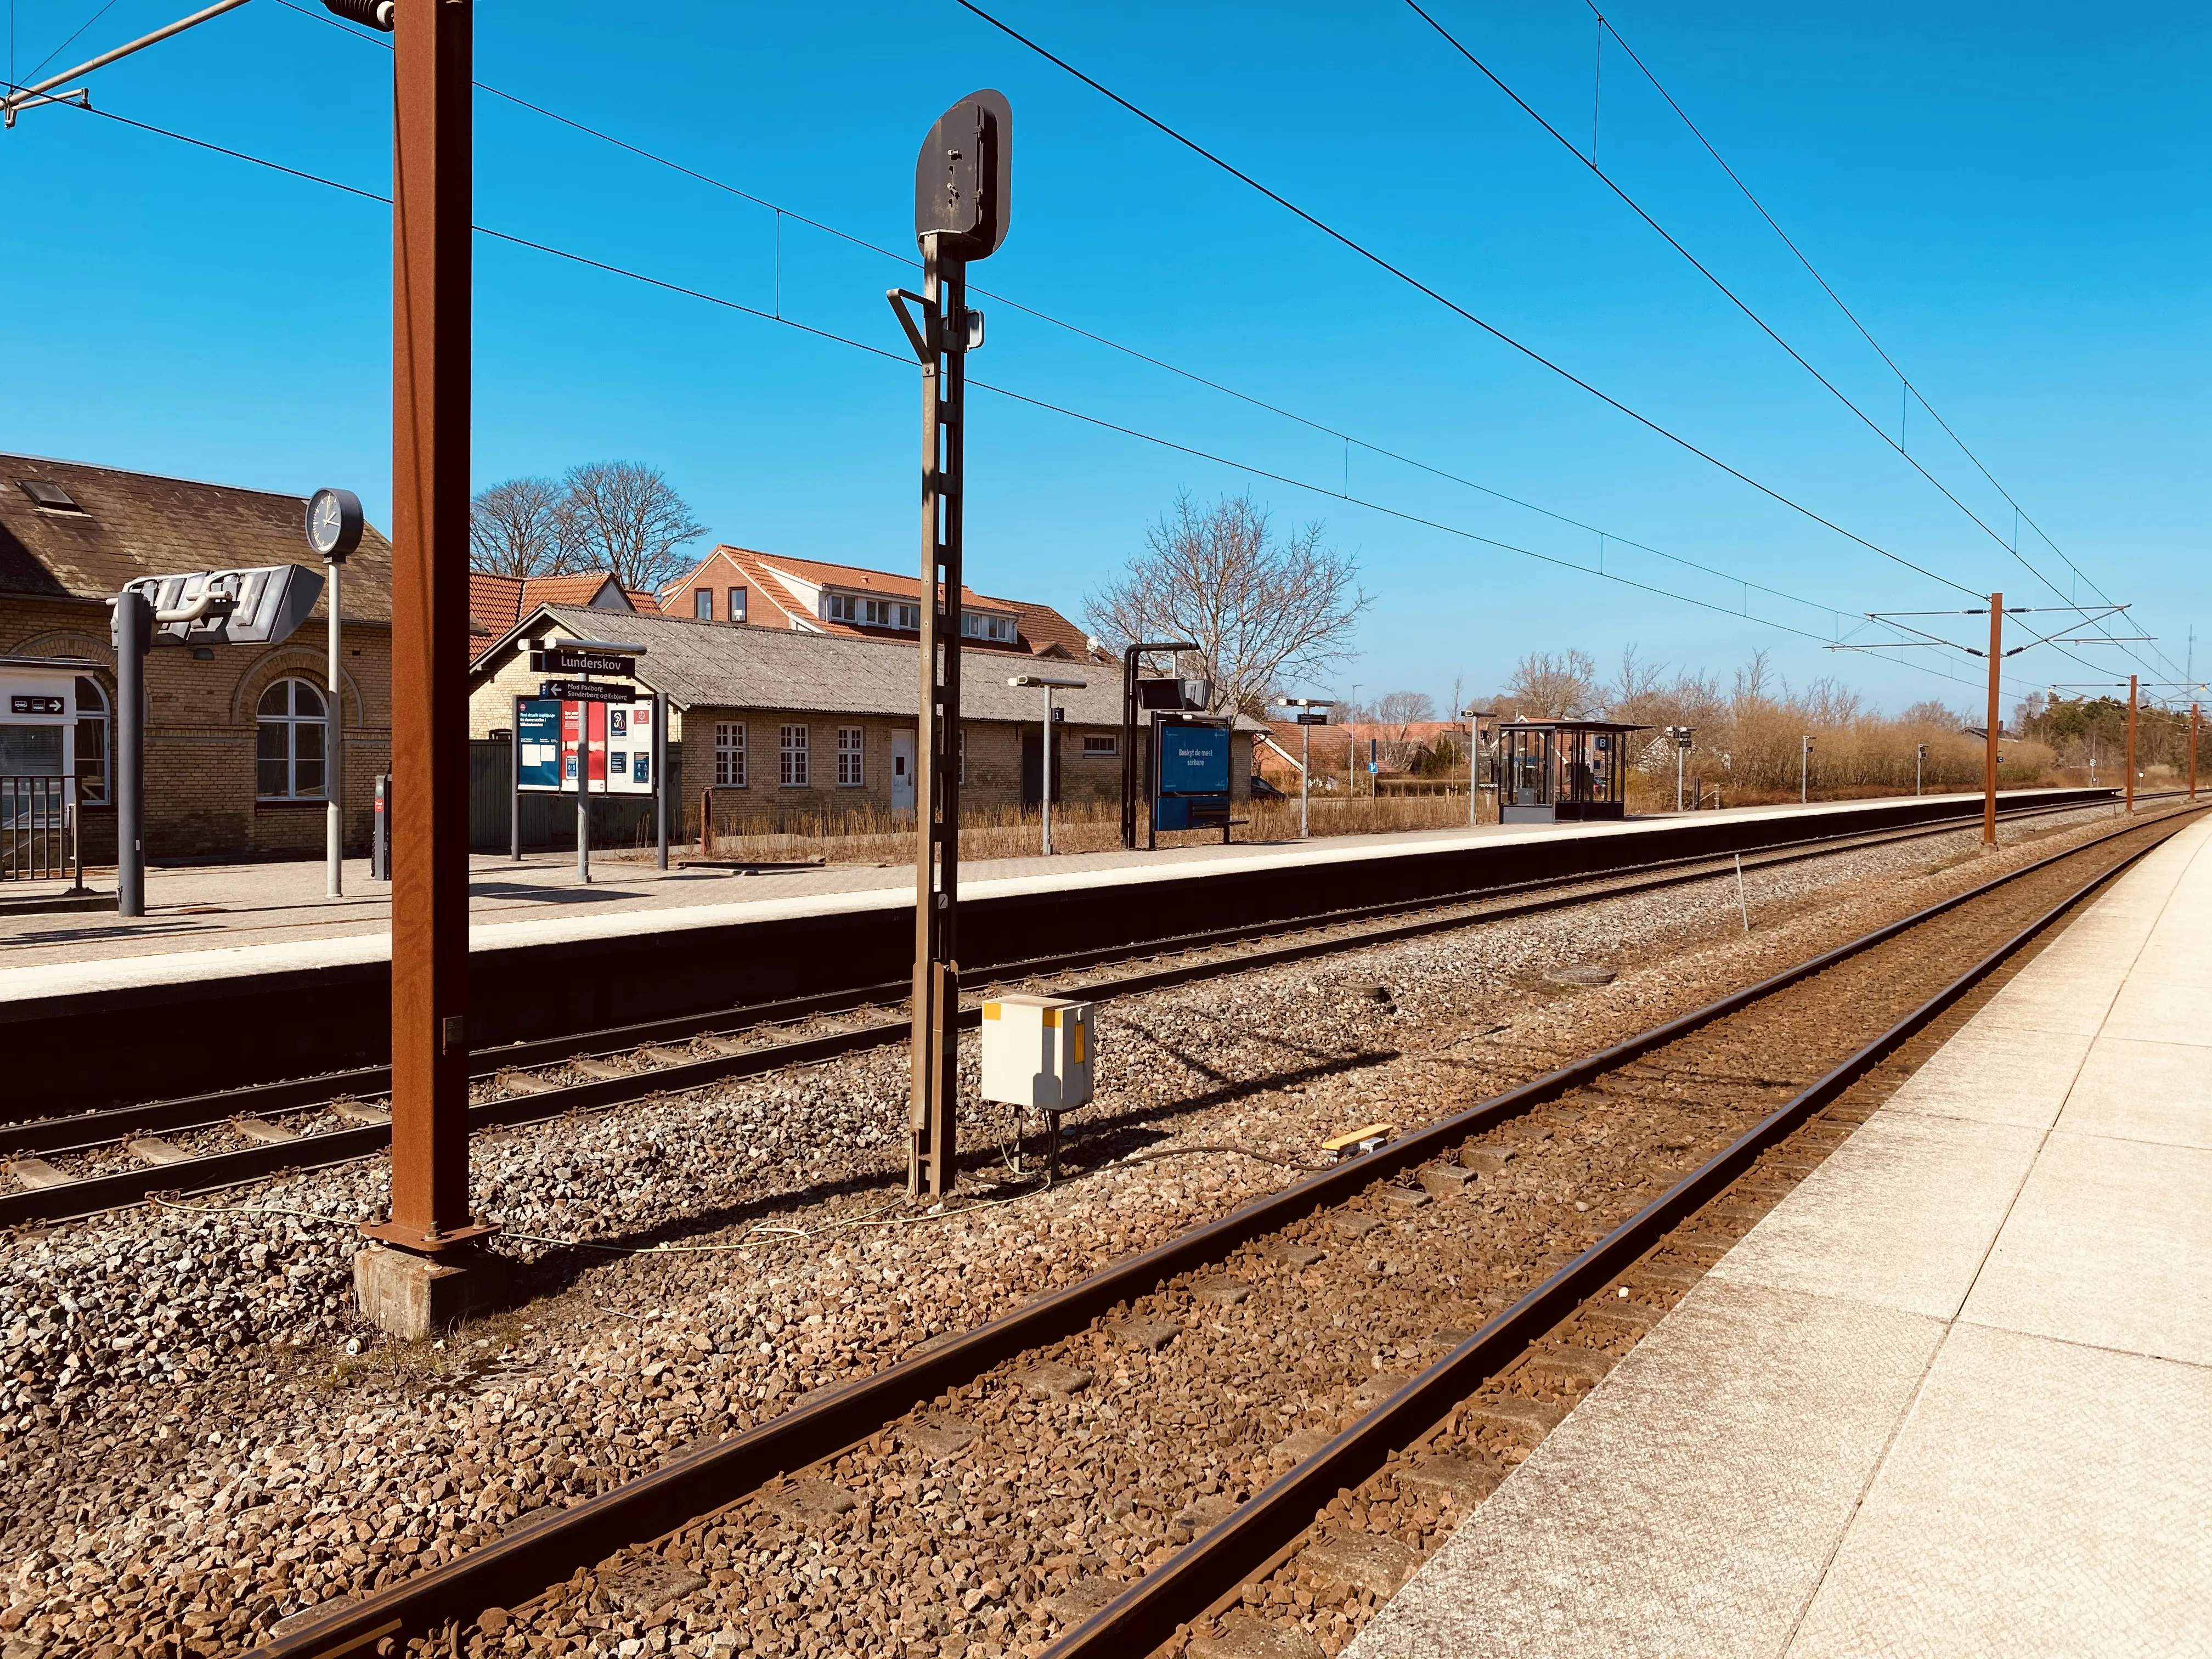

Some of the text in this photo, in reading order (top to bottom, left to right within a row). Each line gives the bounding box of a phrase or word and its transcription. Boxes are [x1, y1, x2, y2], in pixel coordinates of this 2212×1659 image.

[561, 656, 621, 670] Lunderskov
[581, 684, 603, 693] Padborg
[567, 690, 599, 699] Sønderborg
[608, 693, 627, 701] Esbjerg
[1600, 738, 1606, 747] B
[1178, 748, 1194, 758] Beskyt
[1370, 764, 1376, 772] P
